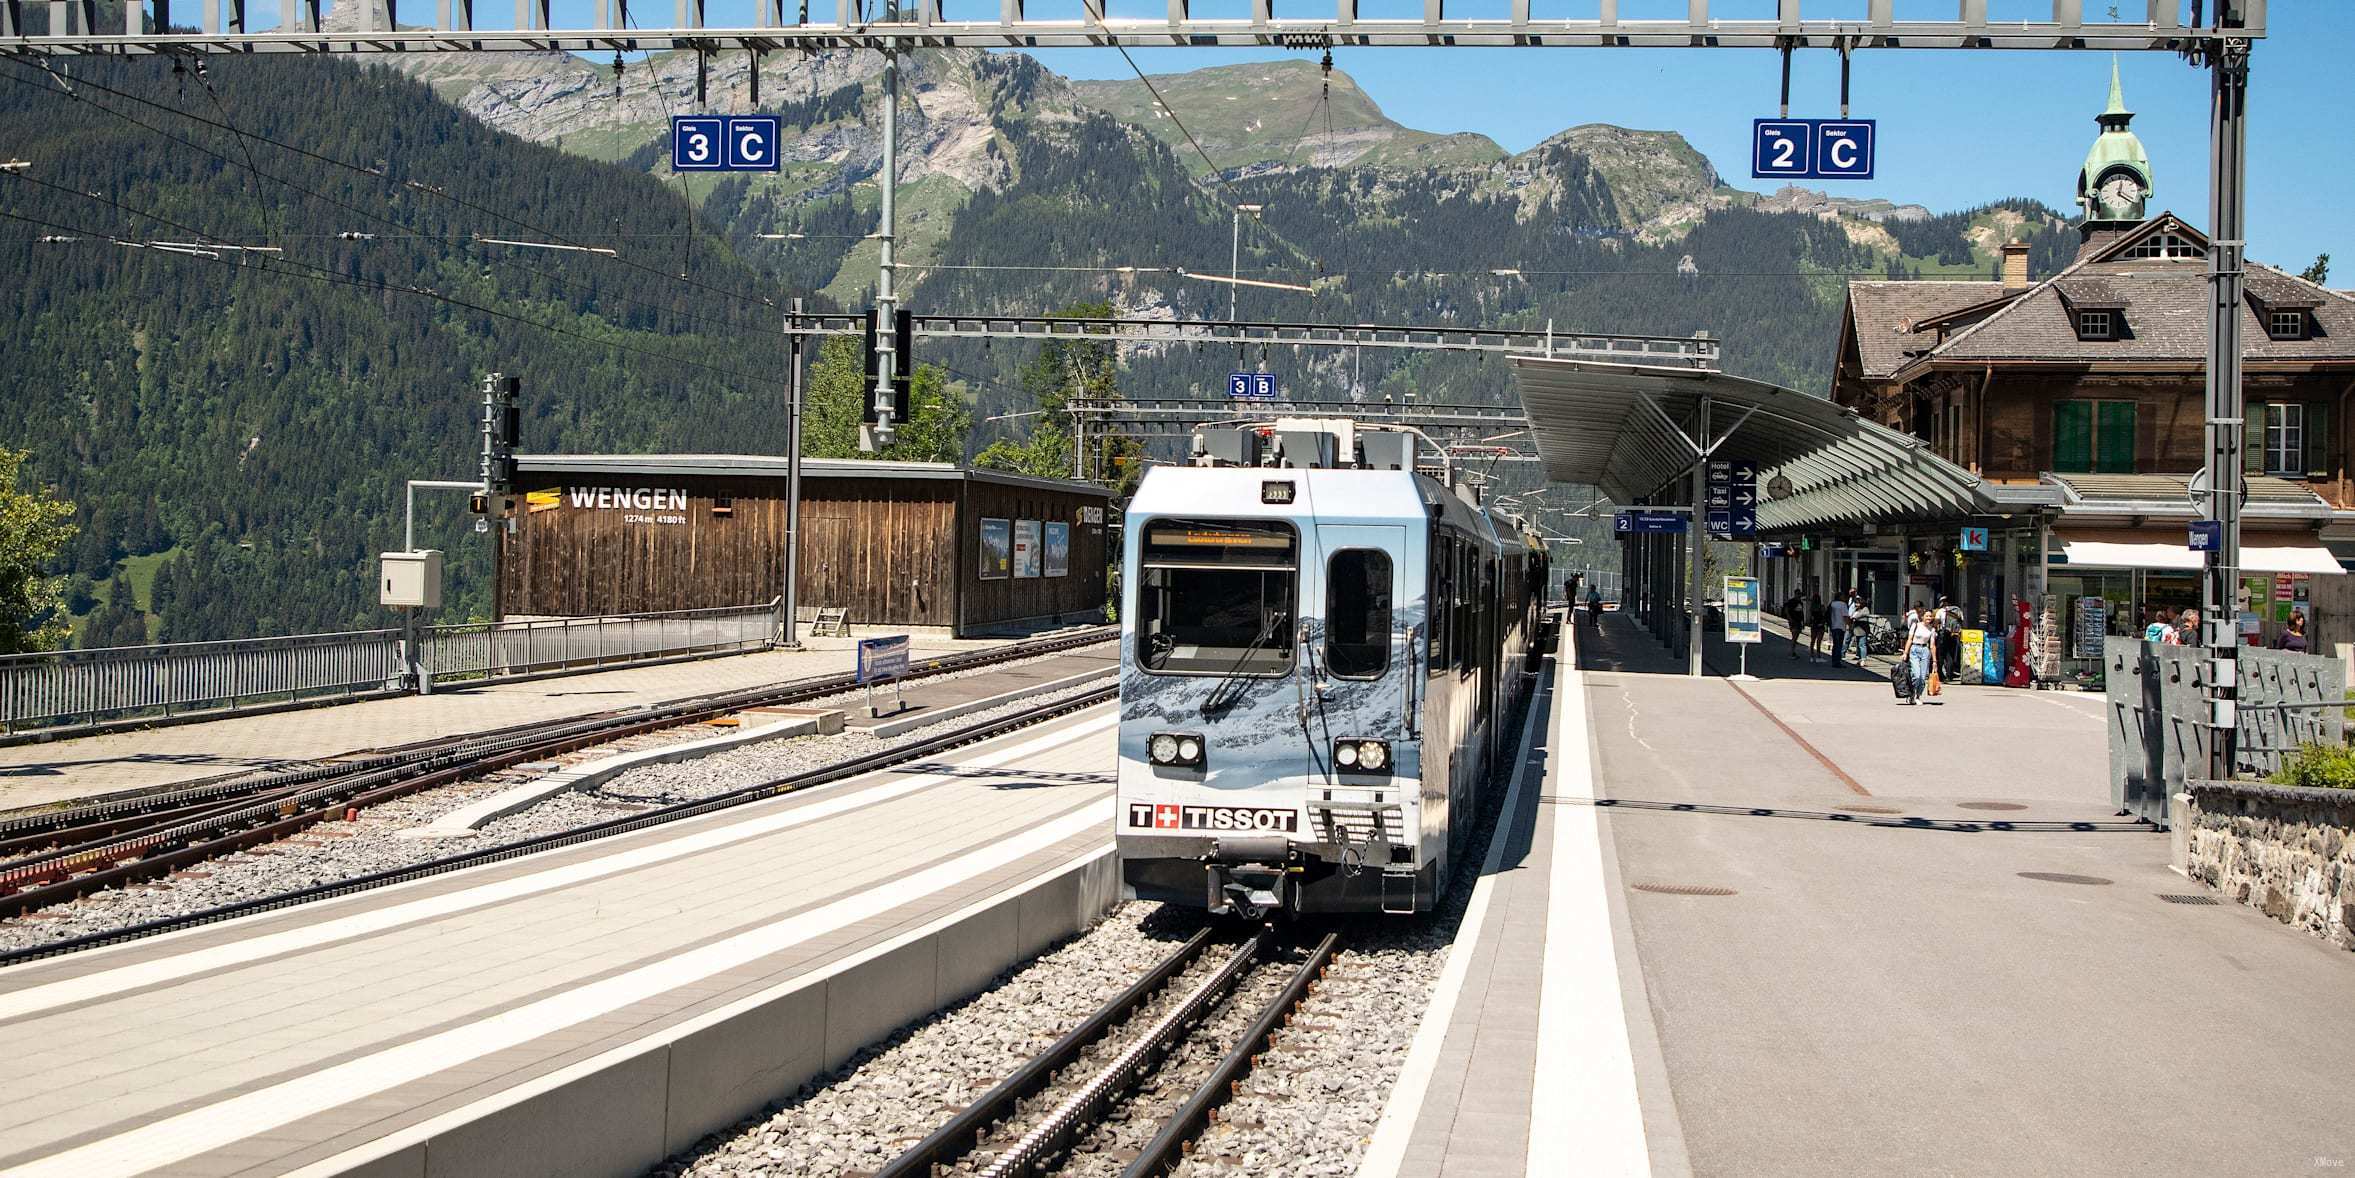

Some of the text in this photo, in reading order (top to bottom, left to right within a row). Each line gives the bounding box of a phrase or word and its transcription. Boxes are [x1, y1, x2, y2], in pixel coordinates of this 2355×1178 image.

[688, 133, 763, 161] 3 C
[1772, 138, 1857, 168] 2 C
[1235, 381, 1269, 393] 3 B
[570, 486, 687, 511] WENGEN
[624, 514, 643, 523] 1274
[657, 515, 677, 524] 4180
[1620, 519, 1628, 529] 2
[1710, 521, 1728, 530] WC
[1970, 530, 1982, 544] k
[1185, 808, 1294, 831] TISSOT
